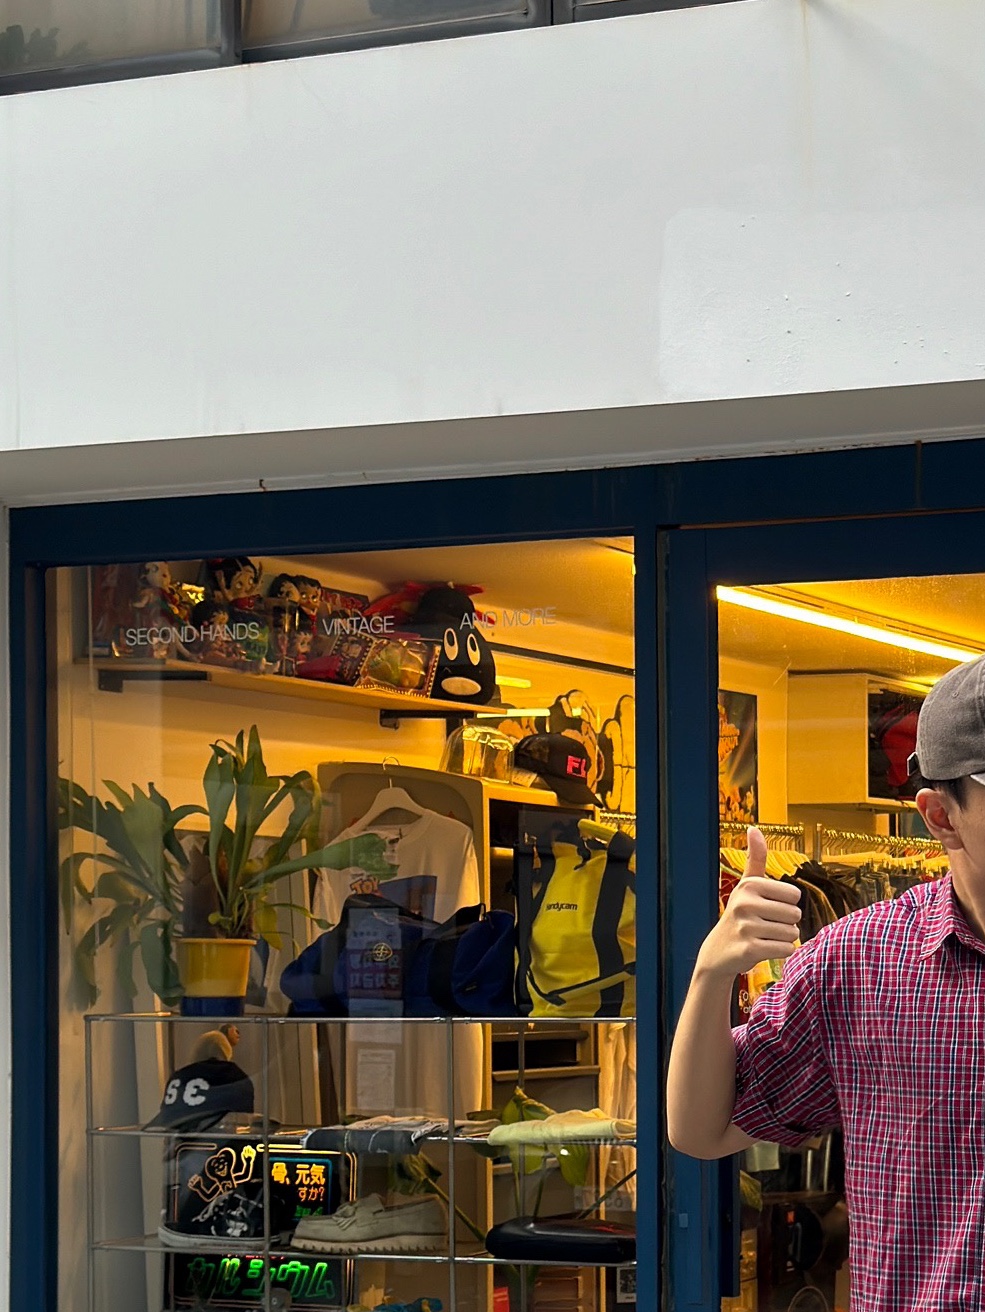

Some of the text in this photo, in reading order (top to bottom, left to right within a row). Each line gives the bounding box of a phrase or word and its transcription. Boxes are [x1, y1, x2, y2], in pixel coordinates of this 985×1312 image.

[323, 615, 395, 636] VINTAGE
[459, 606, 556, 631] AND MORE
[125, 622, 260, 646] SECOND HANDS
